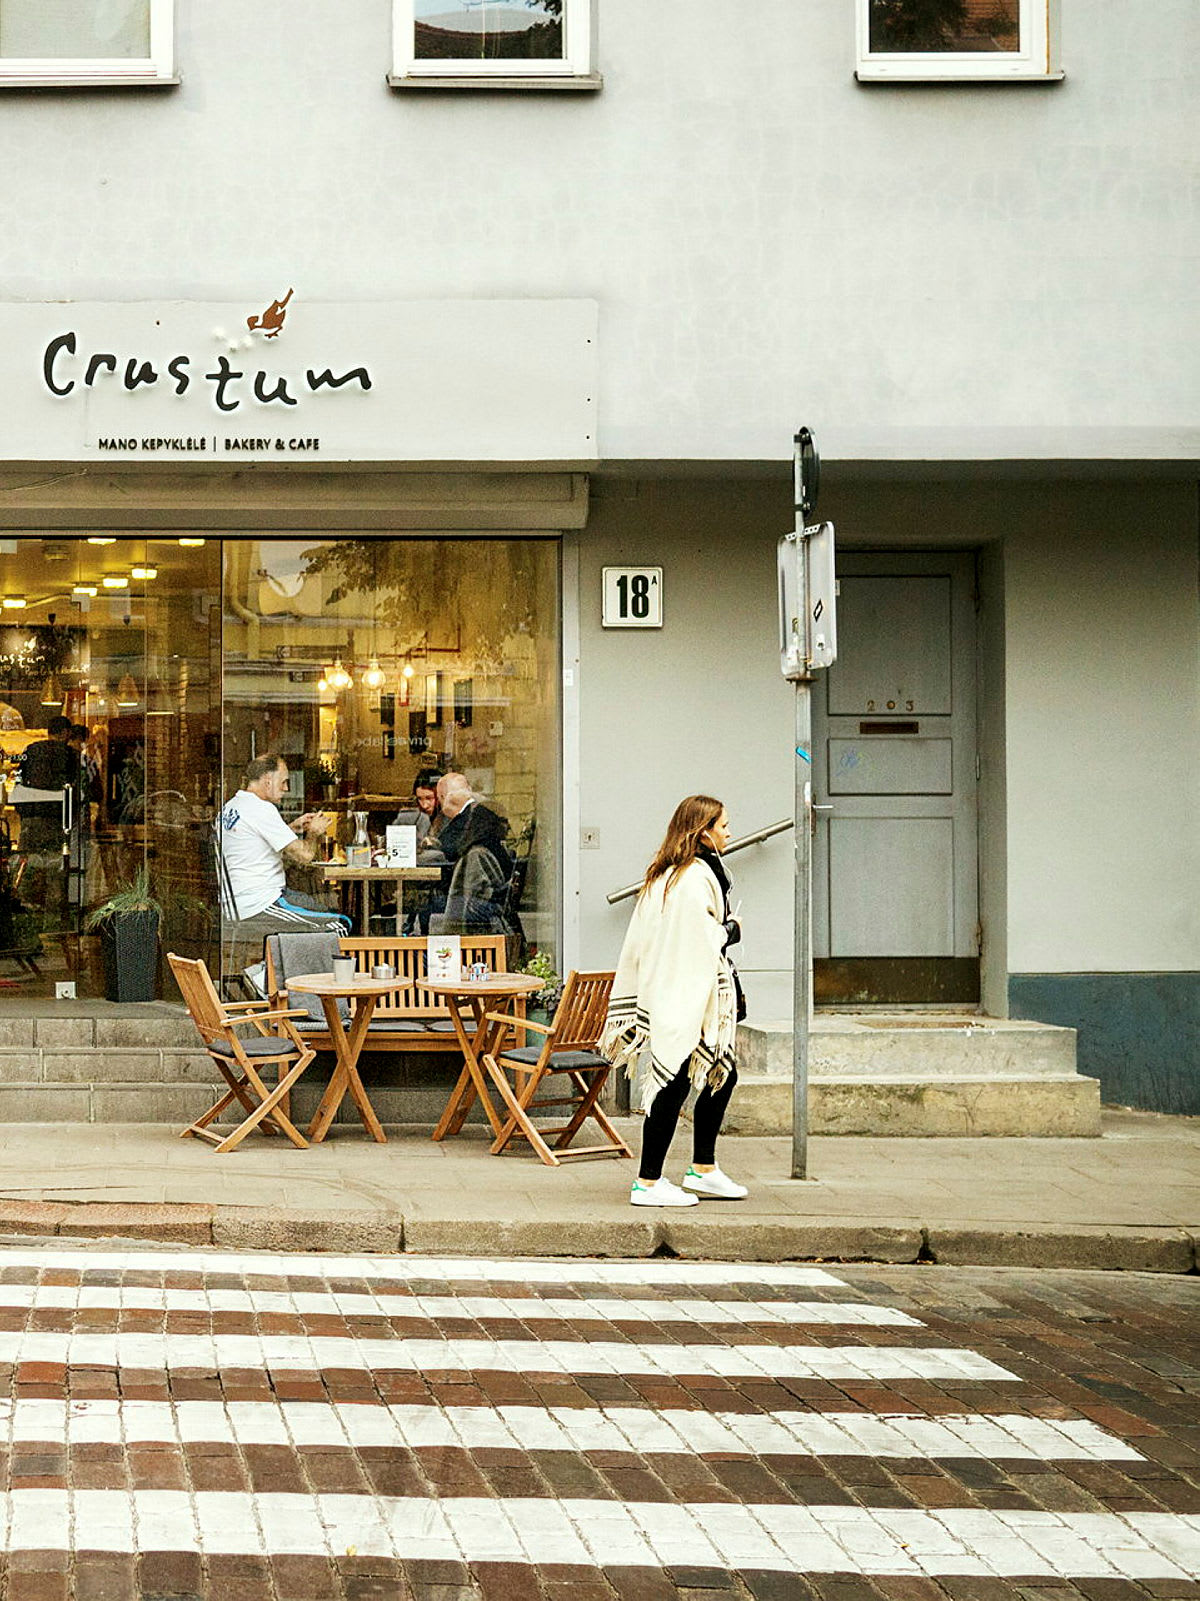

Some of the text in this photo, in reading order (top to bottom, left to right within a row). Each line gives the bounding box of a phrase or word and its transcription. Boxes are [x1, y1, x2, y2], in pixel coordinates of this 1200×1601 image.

[44, 332, 372, 411] Crustum
[98, 437, 319, 450] MANO KEPYKLĖLĖ BAKERY & CAFE
